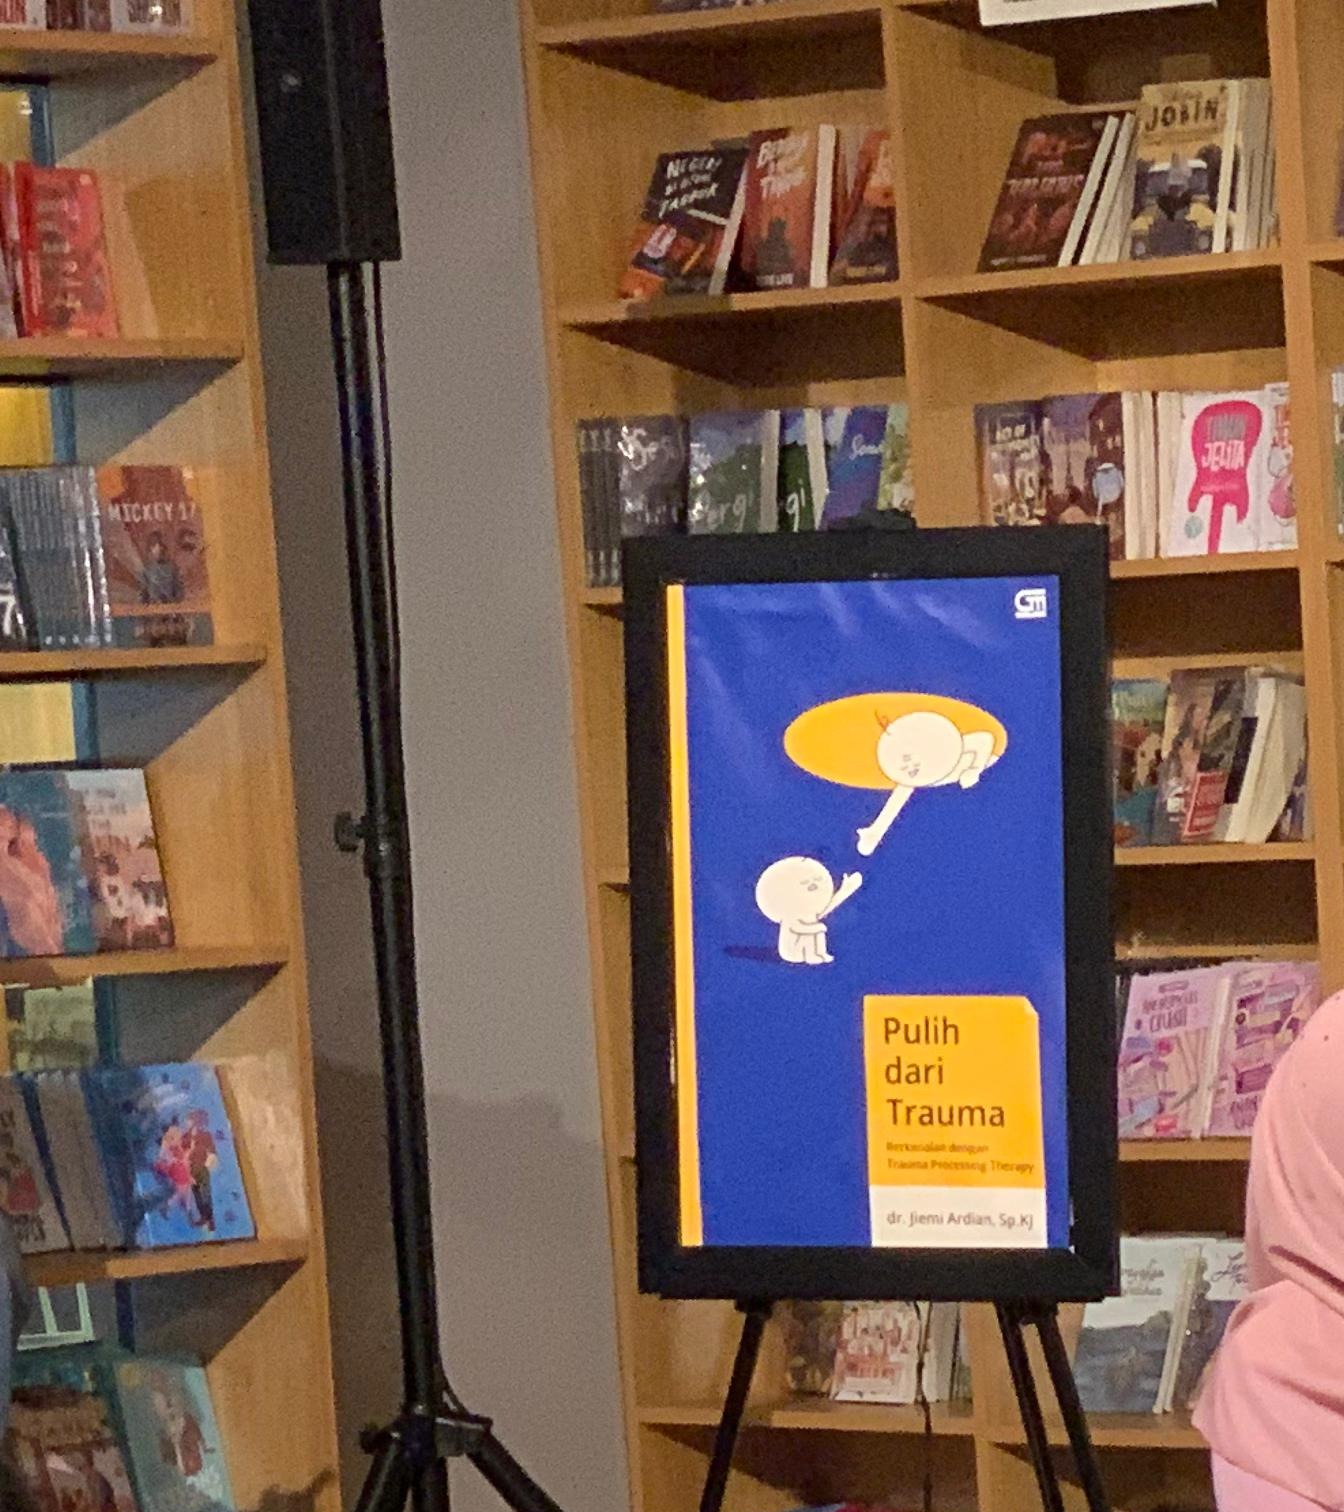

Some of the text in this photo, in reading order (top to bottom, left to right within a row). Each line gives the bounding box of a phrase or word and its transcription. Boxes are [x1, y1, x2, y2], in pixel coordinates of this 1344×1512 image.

[108, 502, 173, 523] MICKEY
[884, 1016, 960, 1045] Pulih
[885, 1055, 944, 1085] dari
[886, 1098, 1005, 1127] Trauma
[887, 1159, 1034, 1174] Trauma Processing Therapy
[887, 1212, 905, 1225] dr.
[909, 1211, 944, 1228] Jiemi
